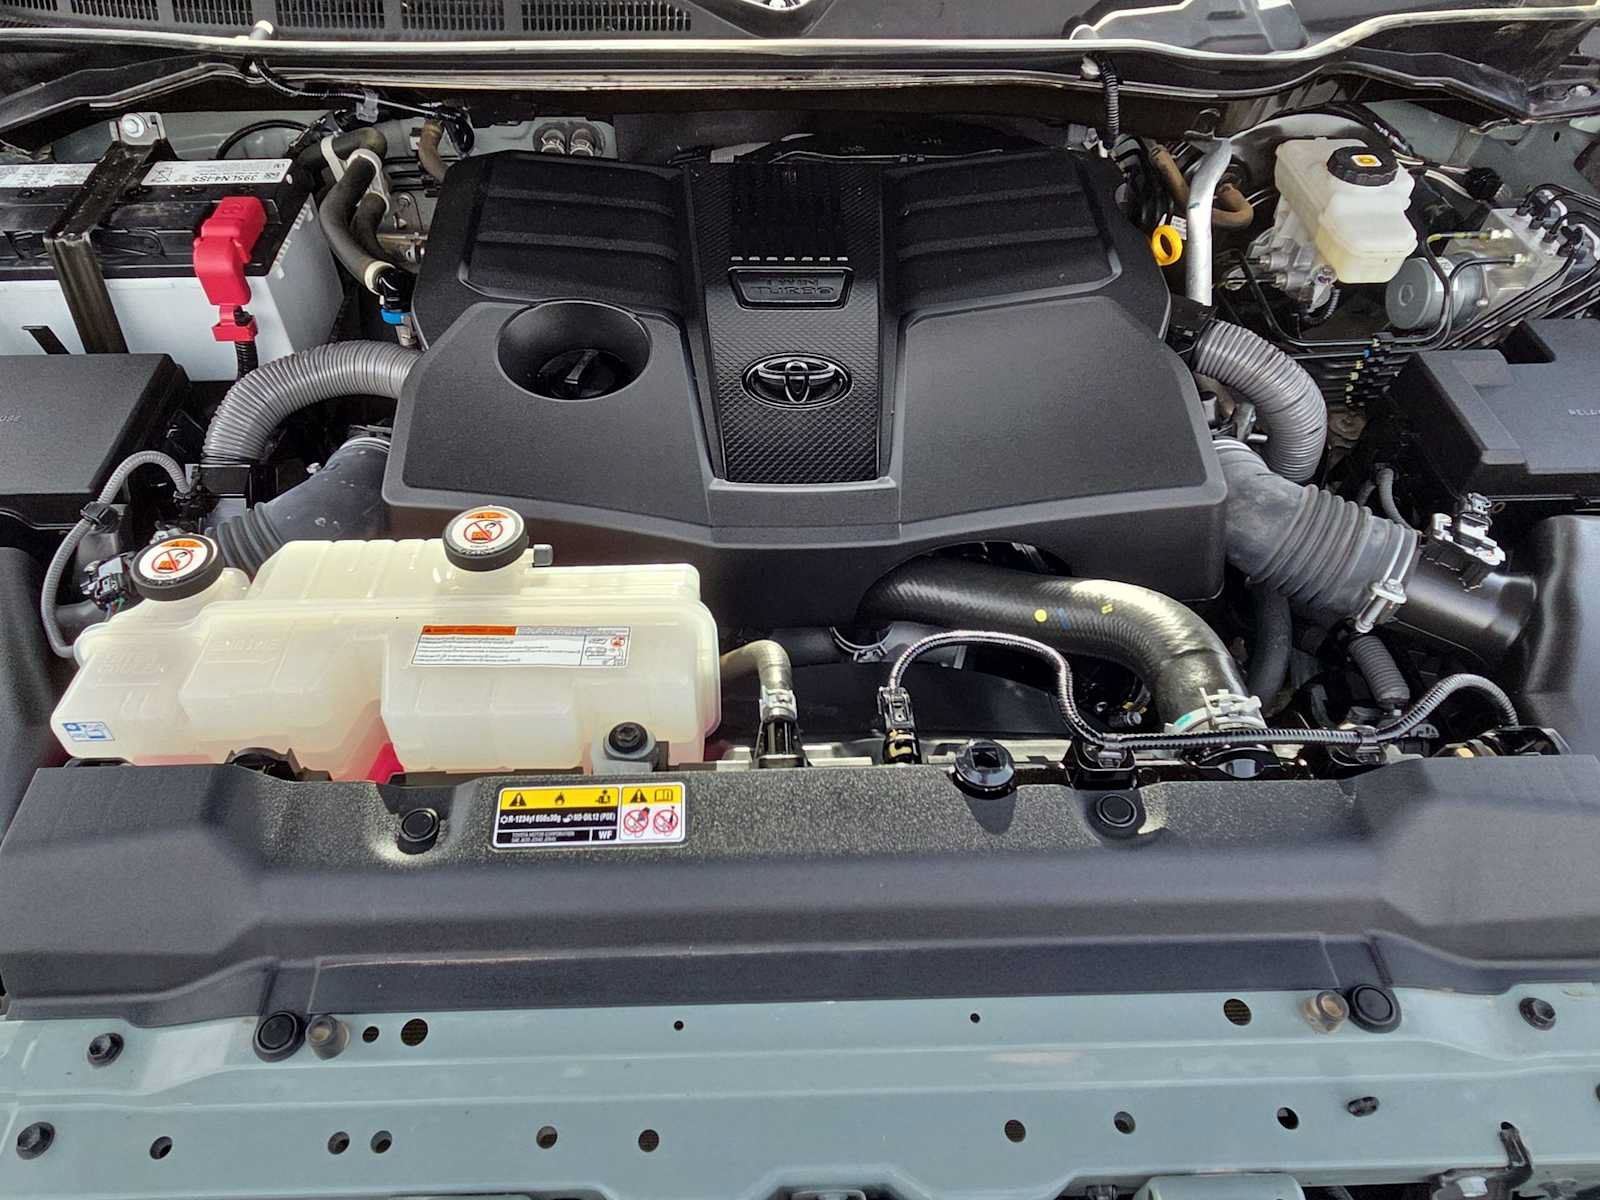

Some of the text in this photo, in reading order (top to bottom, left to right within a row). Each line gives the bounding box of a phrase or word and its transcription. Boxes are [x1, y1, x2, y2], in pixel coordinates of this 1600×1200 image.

[762, 277, 819, 287] TWIN
[750, 286, 834, 295] TURBO
[598, 830, 613, 839] WF
